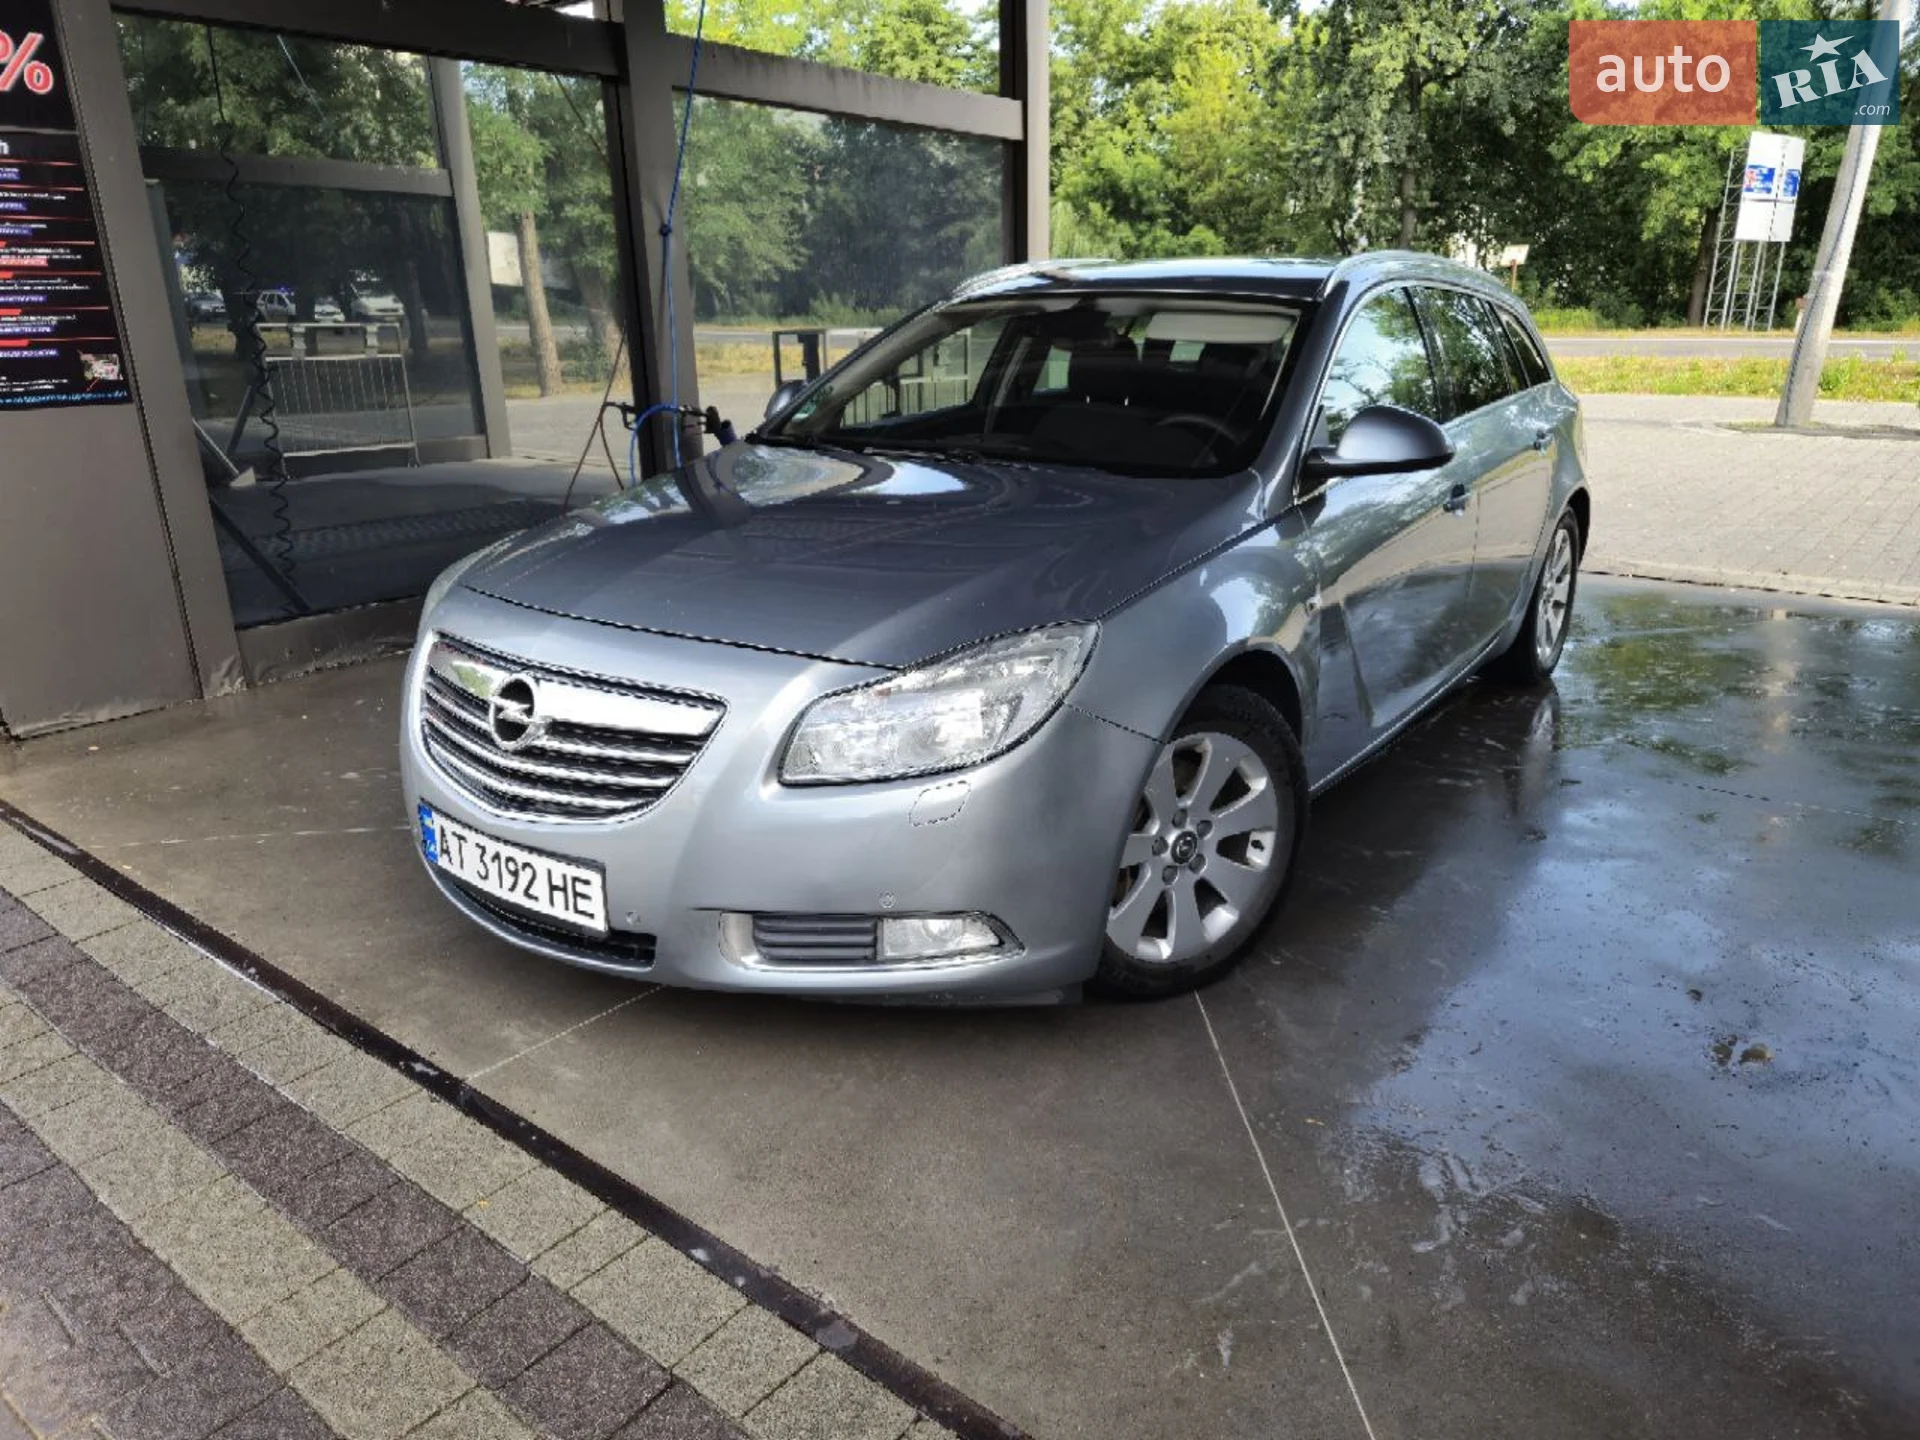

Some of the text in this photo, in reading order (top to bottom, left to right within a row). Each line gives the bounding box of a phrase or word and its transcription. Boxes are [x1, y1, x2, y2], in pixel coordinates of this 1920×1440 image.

[439, 824, 595, 920] AT 3192 HE
